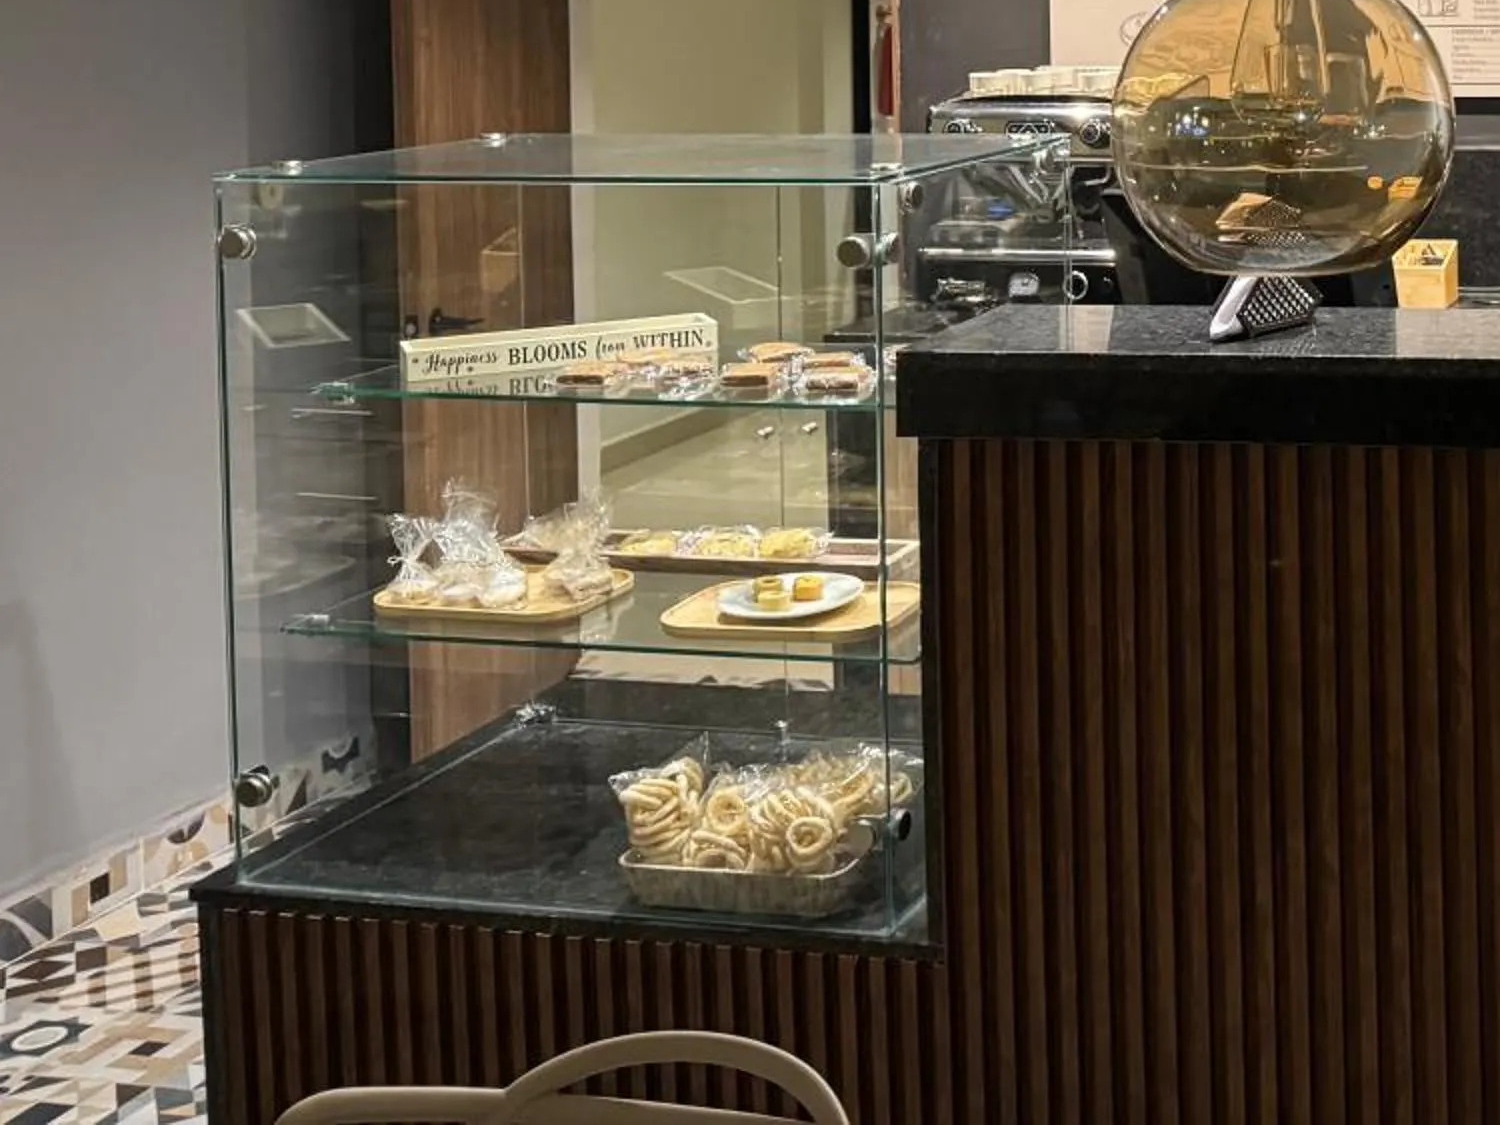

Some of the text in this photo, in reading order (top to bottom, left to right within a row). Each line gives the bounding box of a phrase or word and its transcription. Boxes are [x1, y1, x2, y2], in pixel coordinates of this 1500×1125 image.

[422, 352, 498, 374] Happiness
[508, 340, 588, 366] BLOOMS
[633, 329, 704, 350] WITHIN
